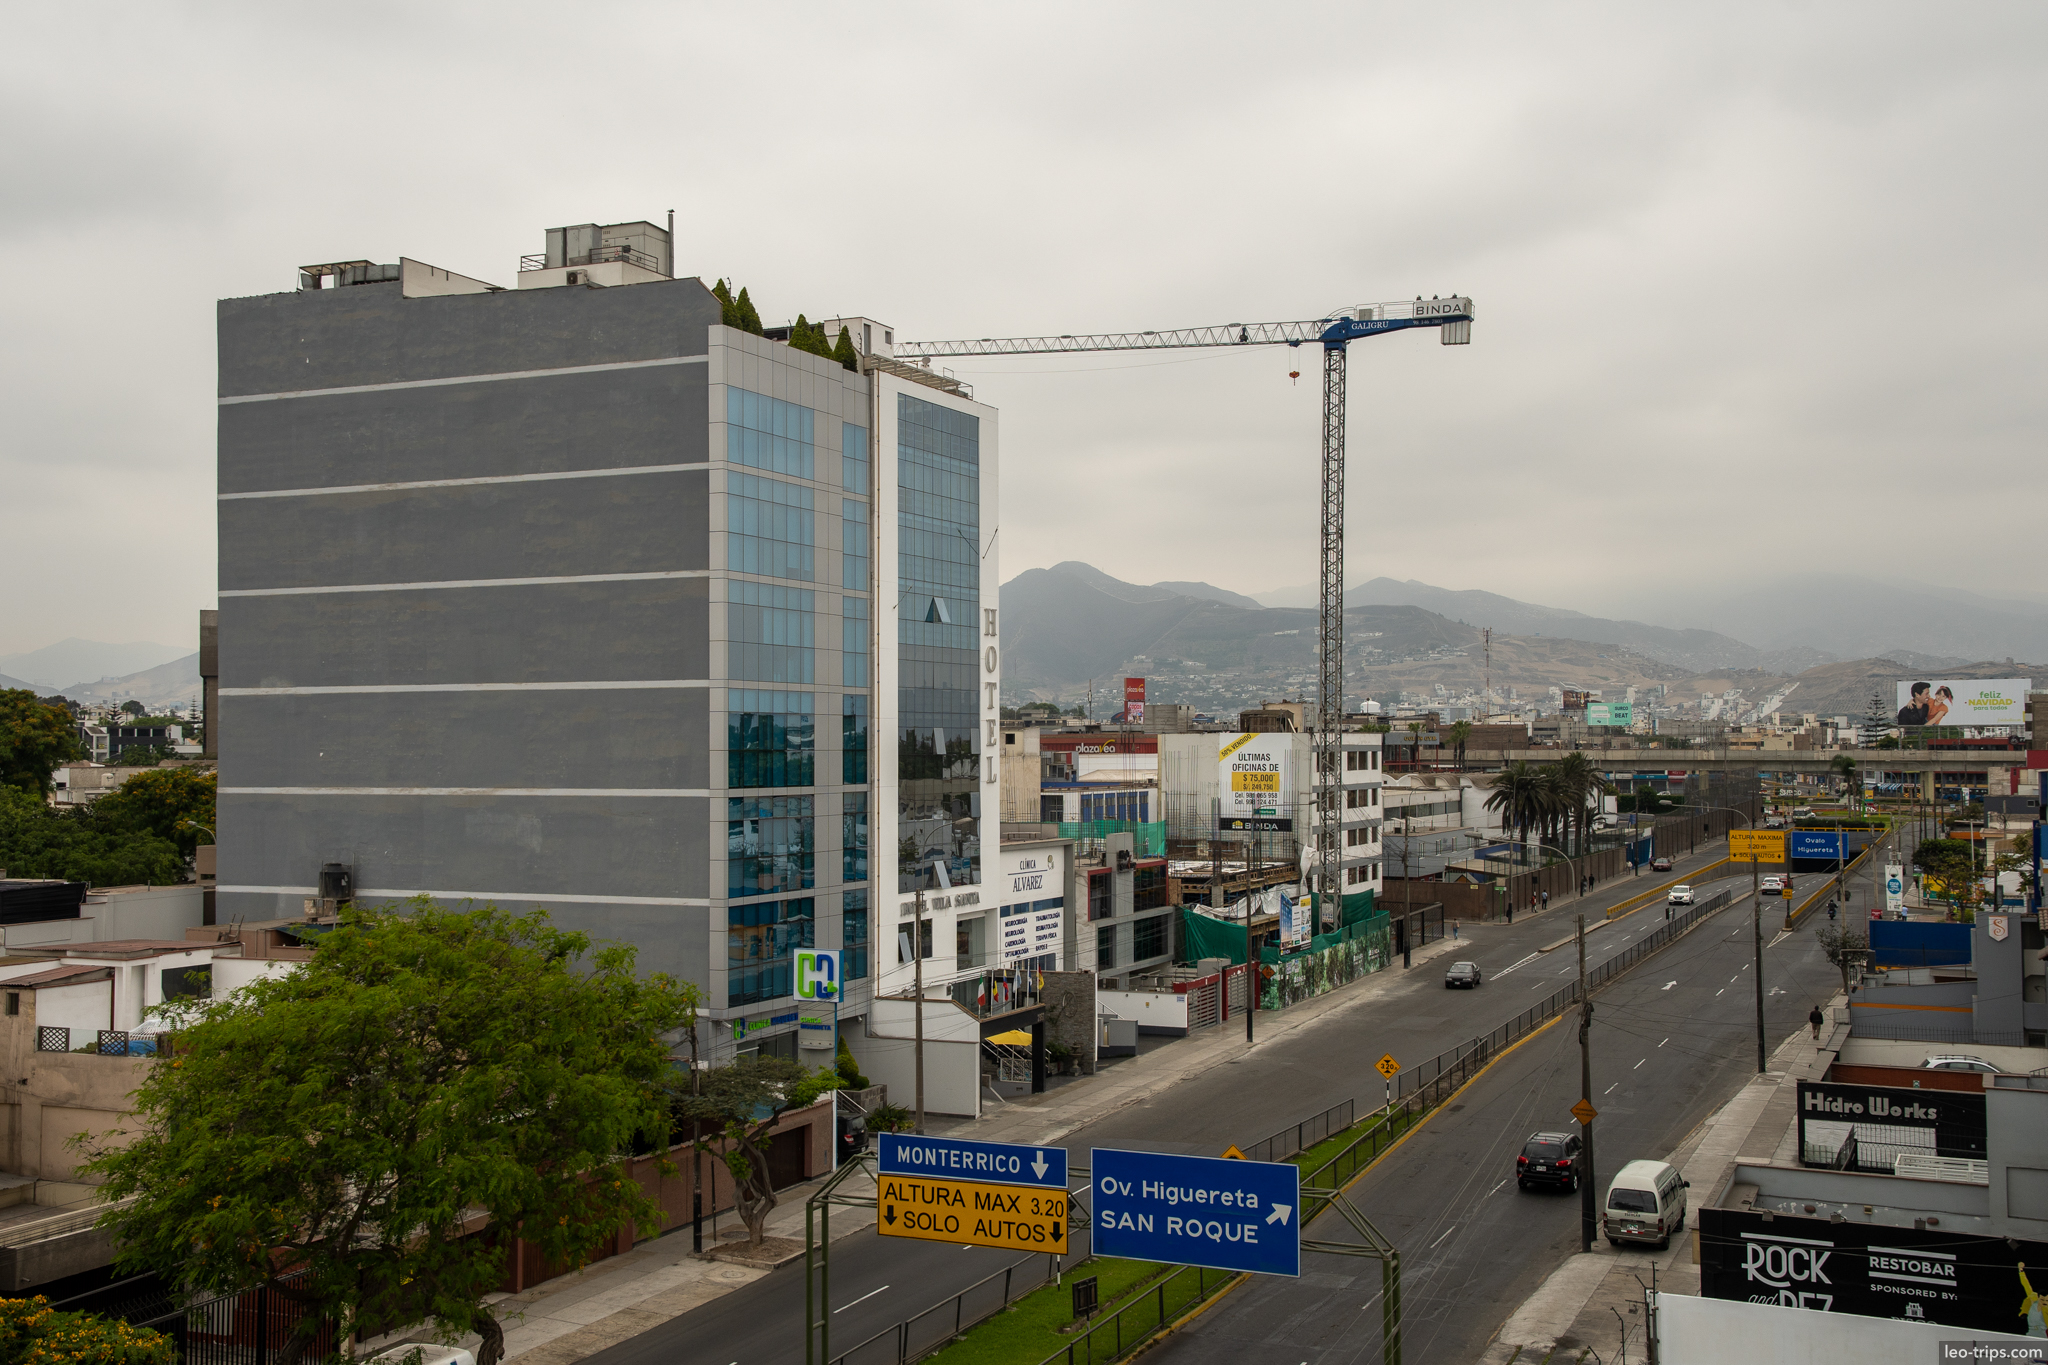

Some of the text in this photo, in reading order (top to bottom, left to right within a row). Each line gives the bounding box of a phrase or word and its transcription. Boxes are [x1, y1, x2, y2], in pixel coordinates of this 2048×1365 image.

[1416, 303, 1462, 316] BINDA
[1351, 321, 1389, 330] GALIGRU
[984, 608, 997, 784] HOTEL
[1980, 691, 2001, 699] feliz
[1221, 734, 1252, 757] 50% VENDIDO
[1238, 752, 1270, 761] ÚLTIMAS
[1243, 774, 1247, 782] $
[1245, 822, 1278, 830] BNDA
[1012, 875, 1042, 892] ALVAREZ
[1869, 1096, 1937, 1119] Works
[897, 1146, 1020, 1174] MONTERRICO
[884, 1182, 1064, 1218] ALTURA MAX 3.20
[1101, 1176, 1258, 1208] Ov. Higuereta
[903, 1211, 1046, 1243] SOLO AUTOS
[1101, 1210, 1258, 1244] SAN ROQUE
[1742, 1243, 1832, 1288] ROCK
[1869, 1256, 1955, 1276] RESTOBAR
[1870, 1284, 1958, 1300] SPONSORED BY:
